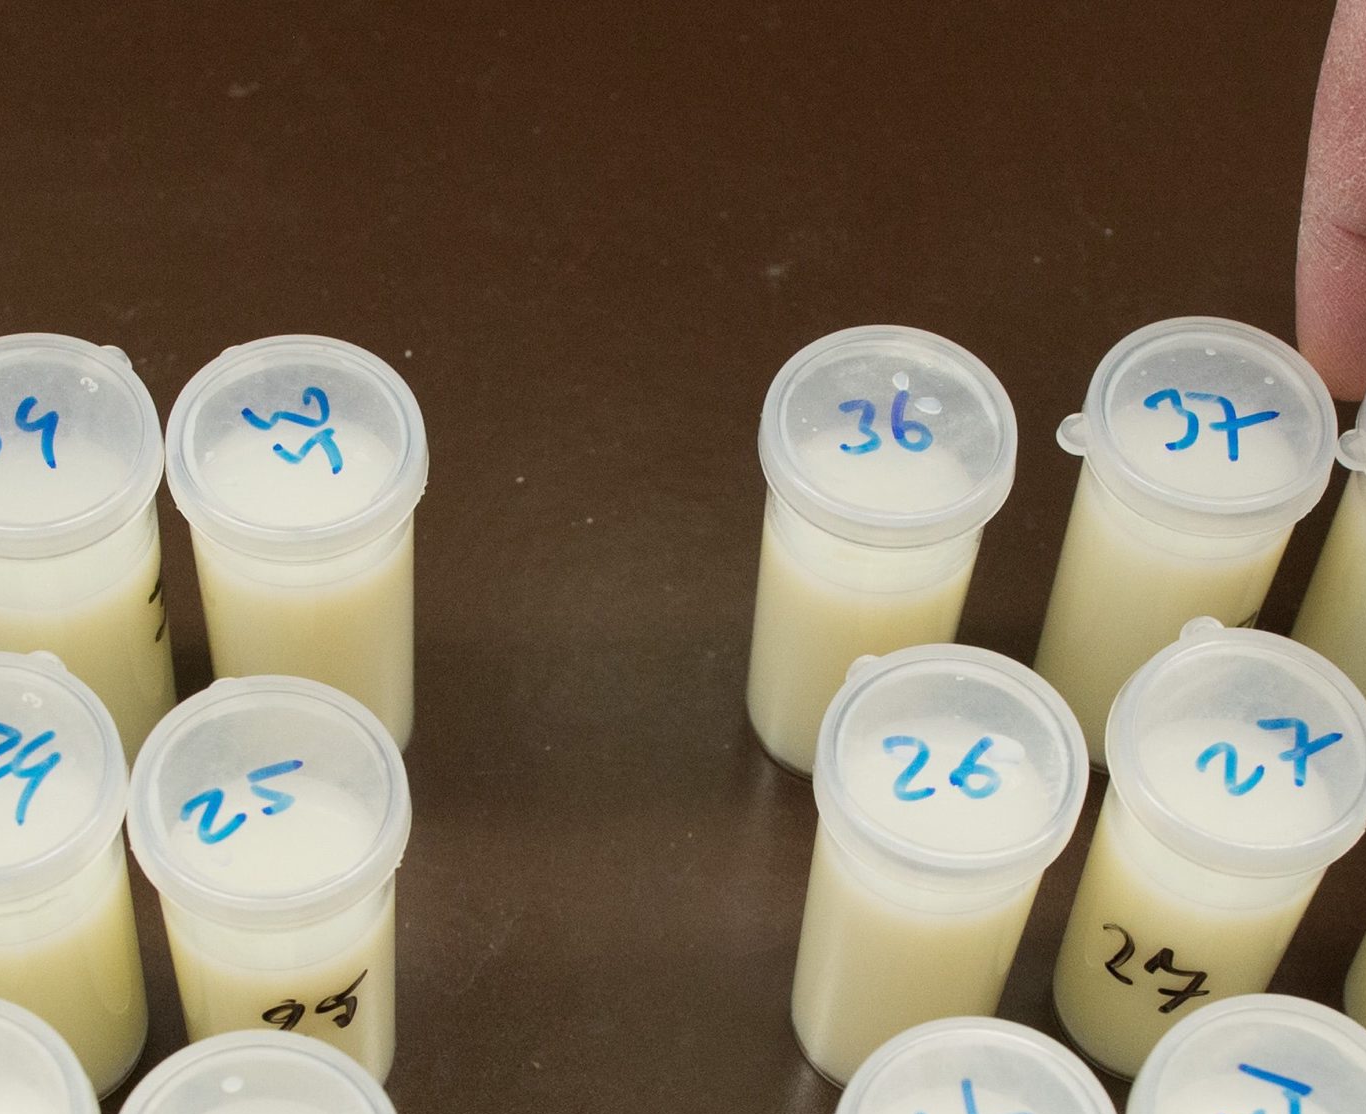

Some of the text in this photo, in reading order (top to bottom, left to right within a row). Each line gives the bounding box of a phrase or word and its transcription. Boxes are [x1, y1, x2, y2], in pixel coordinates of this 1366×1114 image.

[838, 389, 934, 457] 36
[1142, 386, 1281, 463] 37
[882, 735, 999, 802] 26
[1195, 715, 1345, 797] 27
[180, 759, 303, 846] 25
[1103, 922, 1211, 1014] 27
